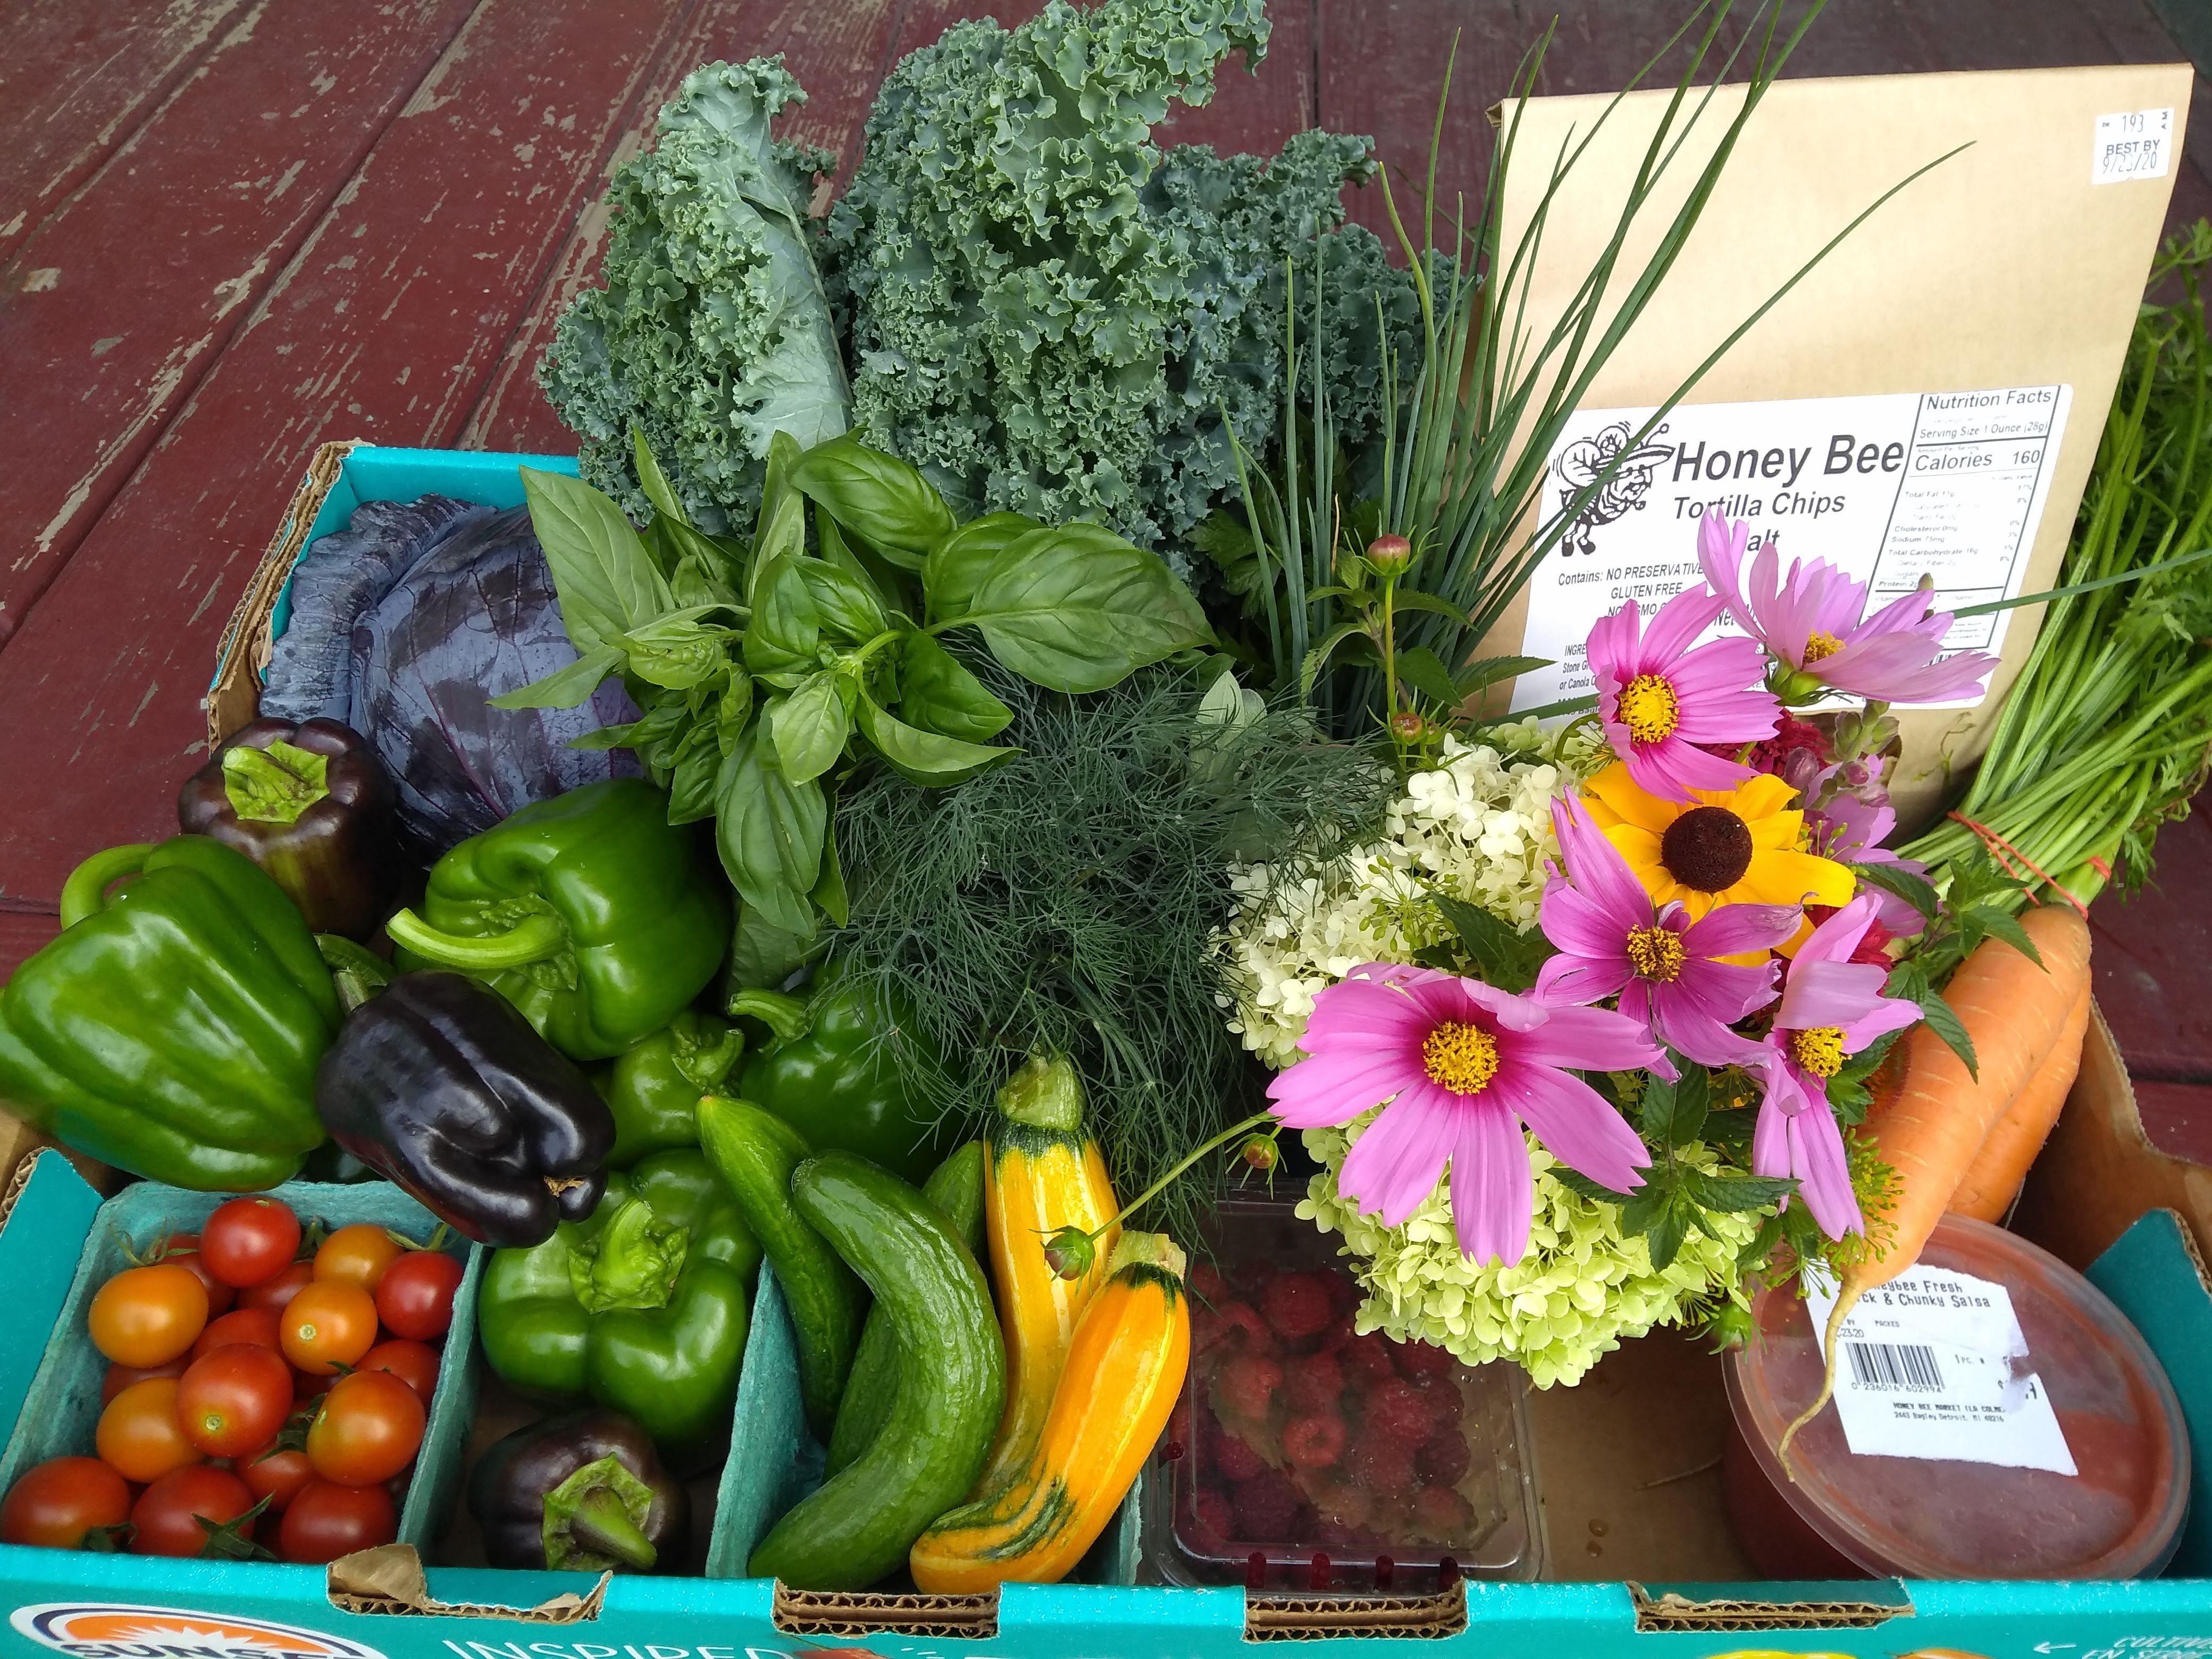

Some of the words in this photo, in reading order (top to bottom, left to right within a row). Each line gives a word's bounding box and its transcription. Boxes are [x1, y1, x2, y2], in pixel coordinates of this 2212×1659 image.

[2123, 114, 2144, 133] 193
[2106, 141, 2140, 156] BEST
[2143, 139, 2160, 152] BY
[1926, 392, 2000, 410] Nutrition
[2006, 390, 2051, 405] Facts
[1920, 429, 1957, 439] Serving
[1960, 426, 1980, 437] Size
[1984, 425, 1988, 434] 1
[1991, 423, 2021, 434] Ounce
[2024, 421, 2048, 433] (28g)
[1672, 441, 1812, 488] Honey
[1824, 434, 1904, 475] Bee
[1915, 452, 1993, 471] Calories
[2013, 449, 2041, 465] 160
[1771, 491, 1846, 520] Chips
[1747, 529, 1780, 551] alt
[1558, 571, 1603, 586] Contains:
[1606, 567, 1623, 581] NO
[1611, 584, 1652, 599] GLUTEN
[1655, 582, 1683, 596] FREE
[1564, 643, 1587, 657] INGRE
[1562, 661, 1580, 674] Stone
[1559, 681, 1567, 690] or
[1568, 676, 1590, 690] Canola
[1923, 1280, 1963, 1293] Fresh
[1883, 1293, 1894, 1305] &
[1898, 1293, 1945, 1308] Chunky
[1951, 1295, 1991, 1308] Salsa
